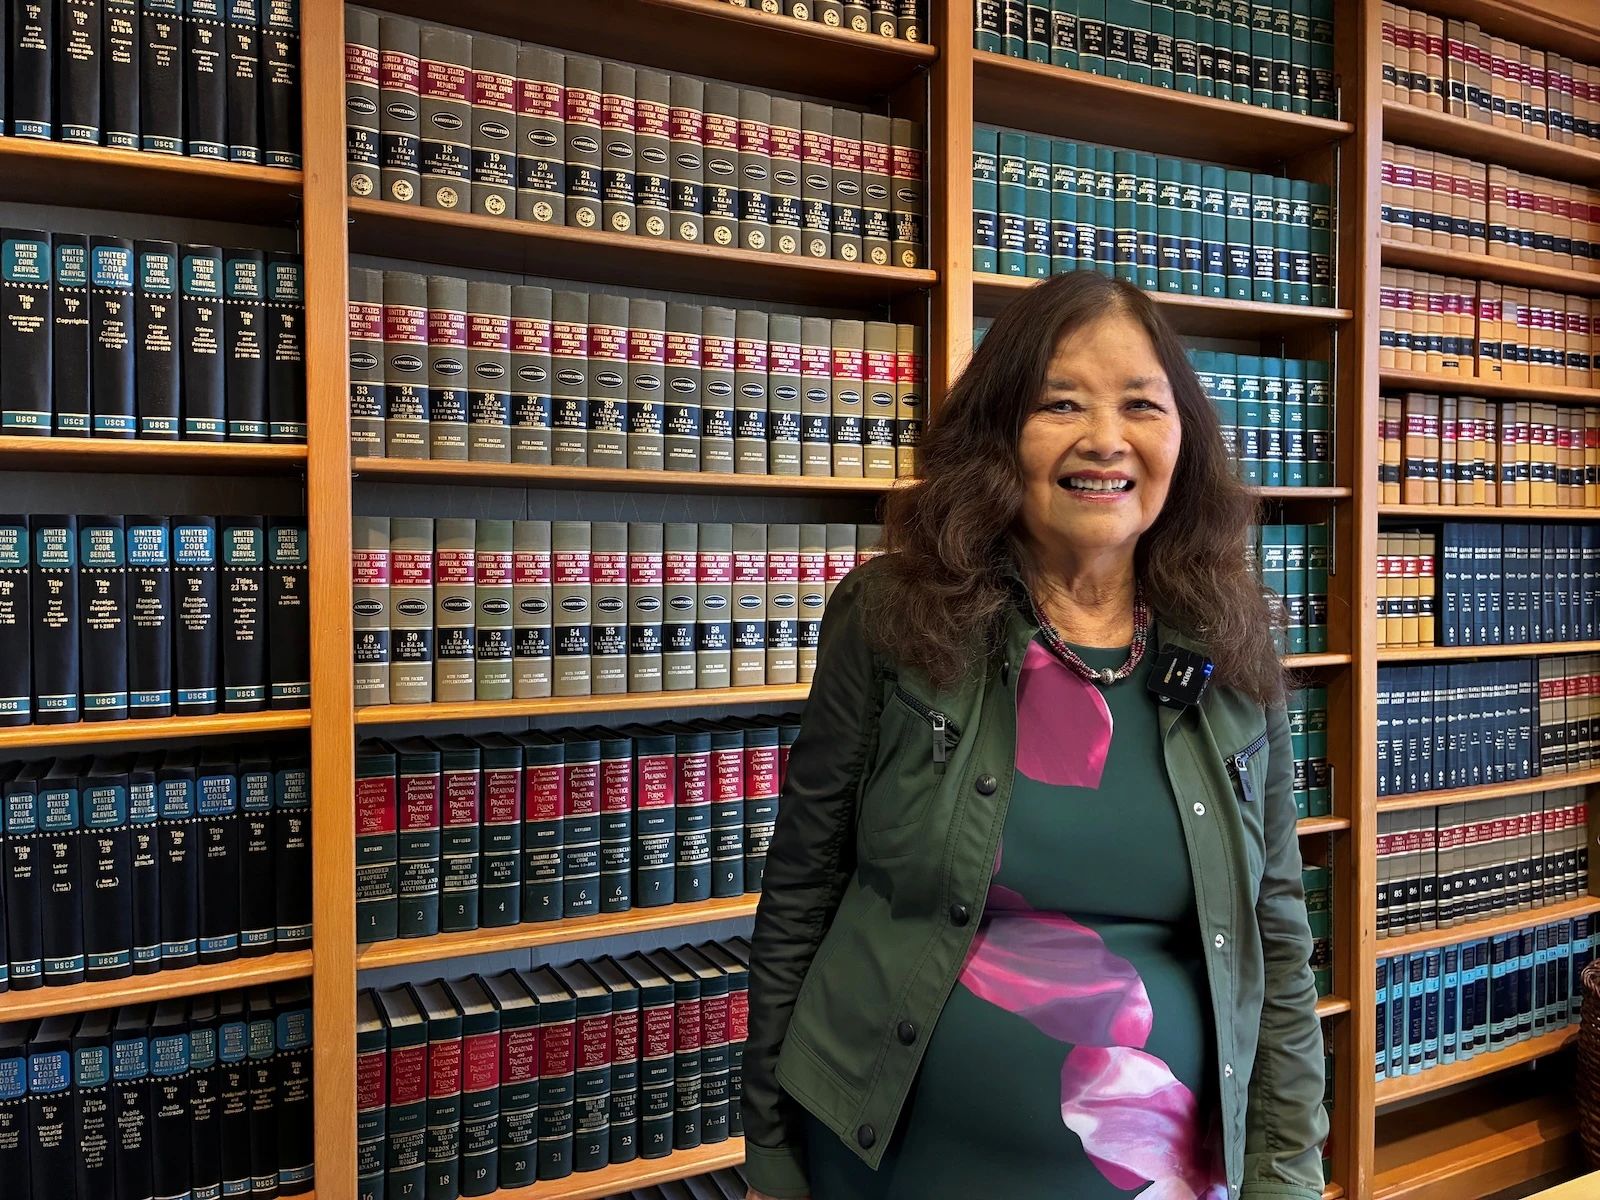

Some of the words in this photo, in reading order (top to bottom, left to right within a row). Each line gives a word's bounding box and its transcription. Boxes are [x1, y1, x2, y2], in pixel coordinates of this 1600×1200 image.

[26, 5, 41, 13] Title
[428, 64, 446, 72] UNITED
[448, 67, 464, 76] STATES
[427, 72, 449, 82] SUPREME
[450, 75, 465, 84] COURT
[436, 81, 456, 90] REPORTS
[434, 116, 461, 126] ANNOTATED
[22, 124, 42, 133] USCS
[356, 132, 366, 141] 16
[154, 139, 174, 149] USCS
[398, 137, 408, 146] 17
[442, 144, 452, 154] 18
[490, 153, 500, 162] 19
[537, 162, 548, 171] 20
[581, 170, 590, 179] 21
[615, 172, 625, 181] 22
[14, 244, 38, 252] UNITED
[15, 250, 38, 258] STATES
[98, 251, 127, 259] UNITED
[98, 258, 127, 266] STATES
[13, 265, 39, 274] SERVICE
[97, 272, 129, 280] SERVICE
[19, 295, 34, 303] Title
[105, 301, 120, 310] Title
[388, 308, 405, 317] UNITED
[387, 316, 408, 324] SUPREME
[410, 318, 424, 326] COURT
[357, 386, 368, 395] 33
[401, 386, 413, 395] 34
[443, 391, 454, 400] 35
[484, 393, 495, 401] 36
[527, 396, 538, 404] 37
[604, 401, 614, 409] 39
[679, 409, 688, 417] 41
[16, 415, 37, 423] USCS
[133, 529, 162, 537] UNITED
[132, 550, 164, 558] SERVICE
[453, 630, 463, 638] 51
[528, 631, 538, 639] 53
[570, 628, 580, 636] 54
[606, 627, 615, 635] 55
[677, 628, 687, 636] 57
[363, 634, 374, 643] 49
[407, 633, 418, 641] 50
[491, 632, 501, 640] 52
[140, 694, 160, 703] USCS
[9, 816, 35, 825] SERVICE
[14, 846, 30, 854] Title
[56, 850, 65, 858] 29
[728, 873, 733, 881] 9
[1482, 876, 1489, 884] 91
[1496, 873, 1503, 881] 92
[655, 882, 659, 890] 7
[693, 879, 699, 887] 8
[1469, 878, 1477, 886] 90
[616, 886, 622, 895] 6
[1409, 887, 1418, 895] 86
[1424, 884, 1433, 893] 87
[580, 890, 586, 899] 6
[1394, 889, 1402, 898] 85
[543, 897, 549, 905] 5
[458, 906, 464, 914] 3
[499, 903, 505, 911] 4
[417, 911, 423, 920] 2
[371, 916, 376, 925] 1
[16, 964, 36, 973] USCS
[33, 1055, 62, 1065] UNITED
[34, 1061, 61, 1071] STATES
[38, 1069, 59, 1078] CODE
[32, 1075, 64, 1085] SERVICE
[703, 1080, 727, 1089] GENERAL
[163, 1086, 178, 1094] Title
[158, 1108, 184, 1117] Contracts
[162, 1104, 180, 1112] Public
[686, 1124, 694, 1133] 25
[622, 1136, 632, 1145] 23
[654, 1134, 663, 1142] 24
[590, 1145, 600, 1154] 22
[553, 1153, 561, 1161] 21
[515, 1162, 526, 1171] 20
[476, 1169, 486, 1178] 19
[439, 1175, 449, 1185] 18
[403, 1184, 413, 1193] 17
